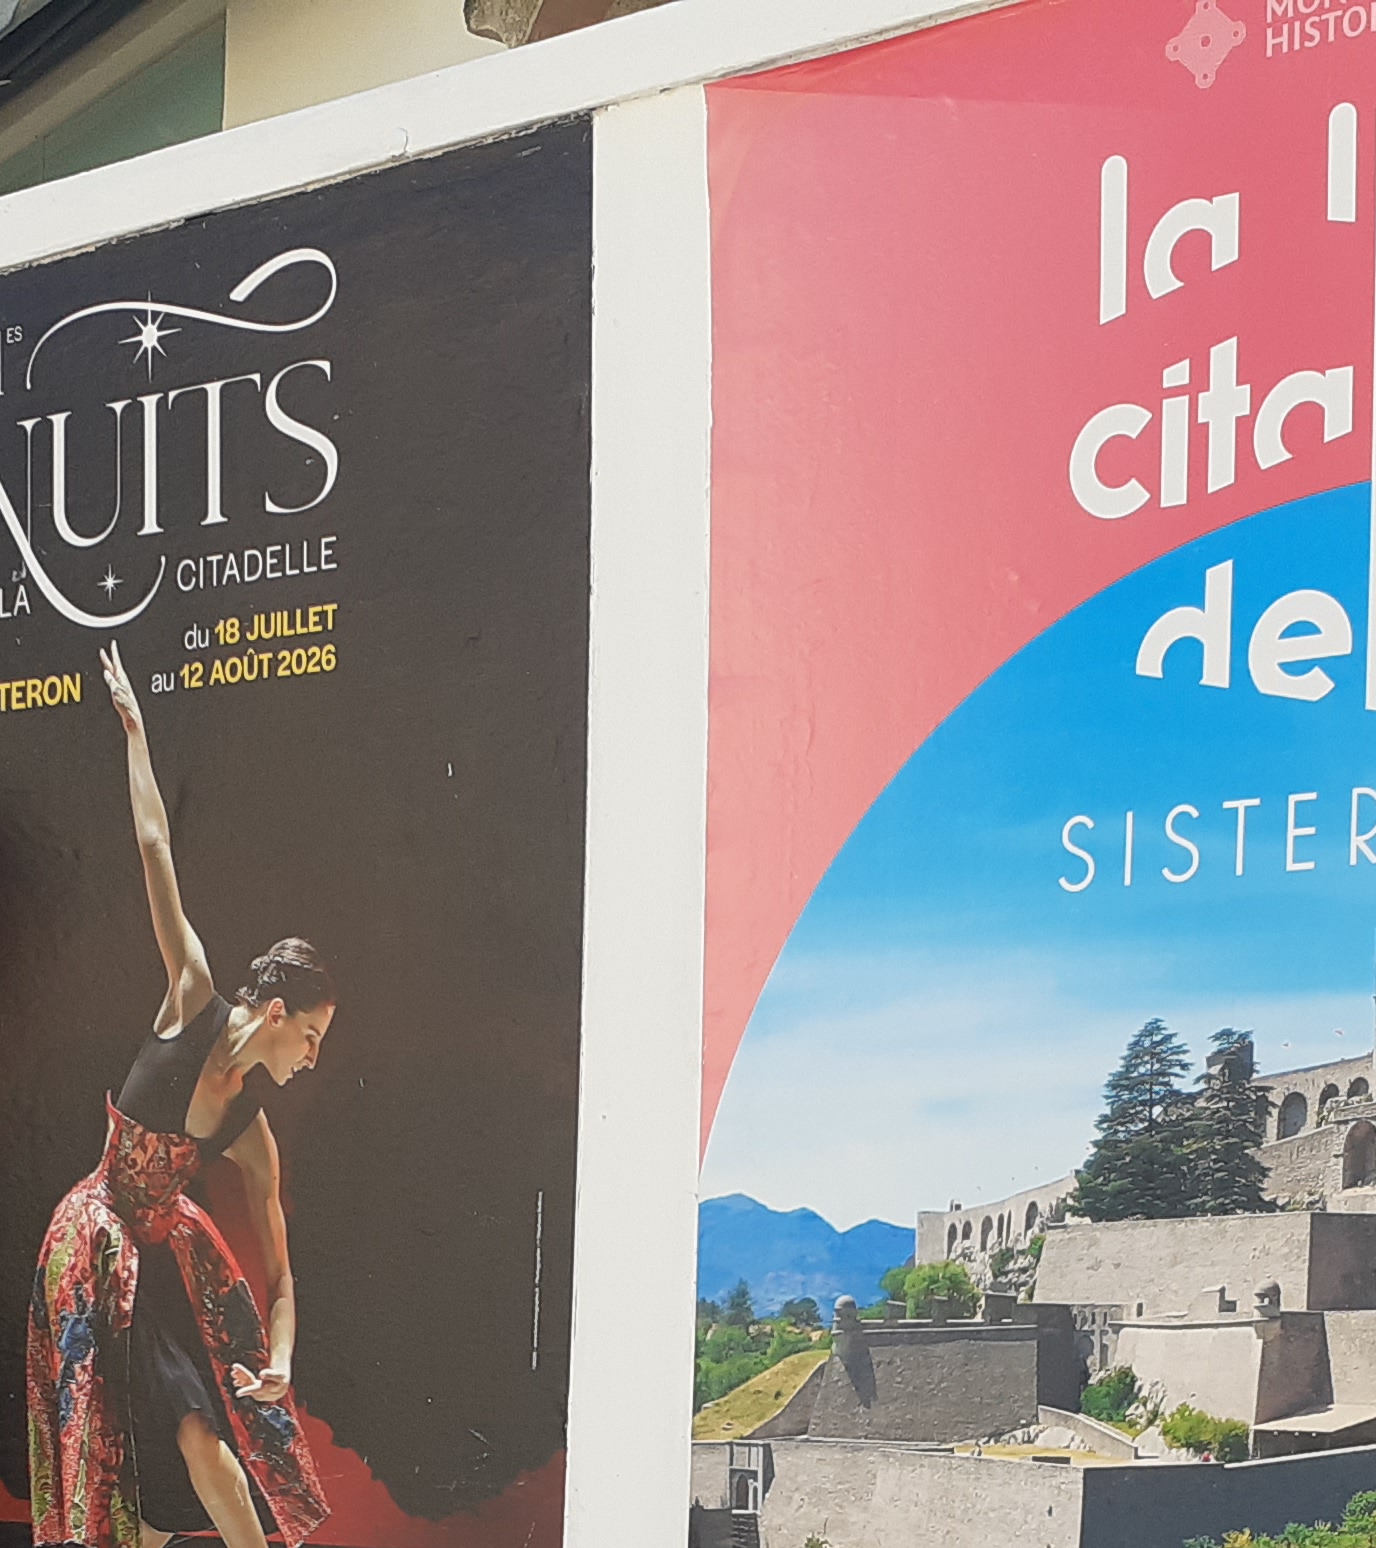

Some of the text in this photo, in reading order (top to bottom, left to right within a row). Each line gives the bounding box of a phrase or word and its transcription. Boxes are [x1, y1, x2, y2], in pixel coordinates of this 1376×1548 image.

[1100, 155, 1240, 325] la
[1069, 335, 1354, 519] cita
[176, 536, 338, 592] CITADELLE
[184, 603, 338, 650] du 18 JUILLET
[151, 644, 337, 693] au 12 AOÛT 2026
